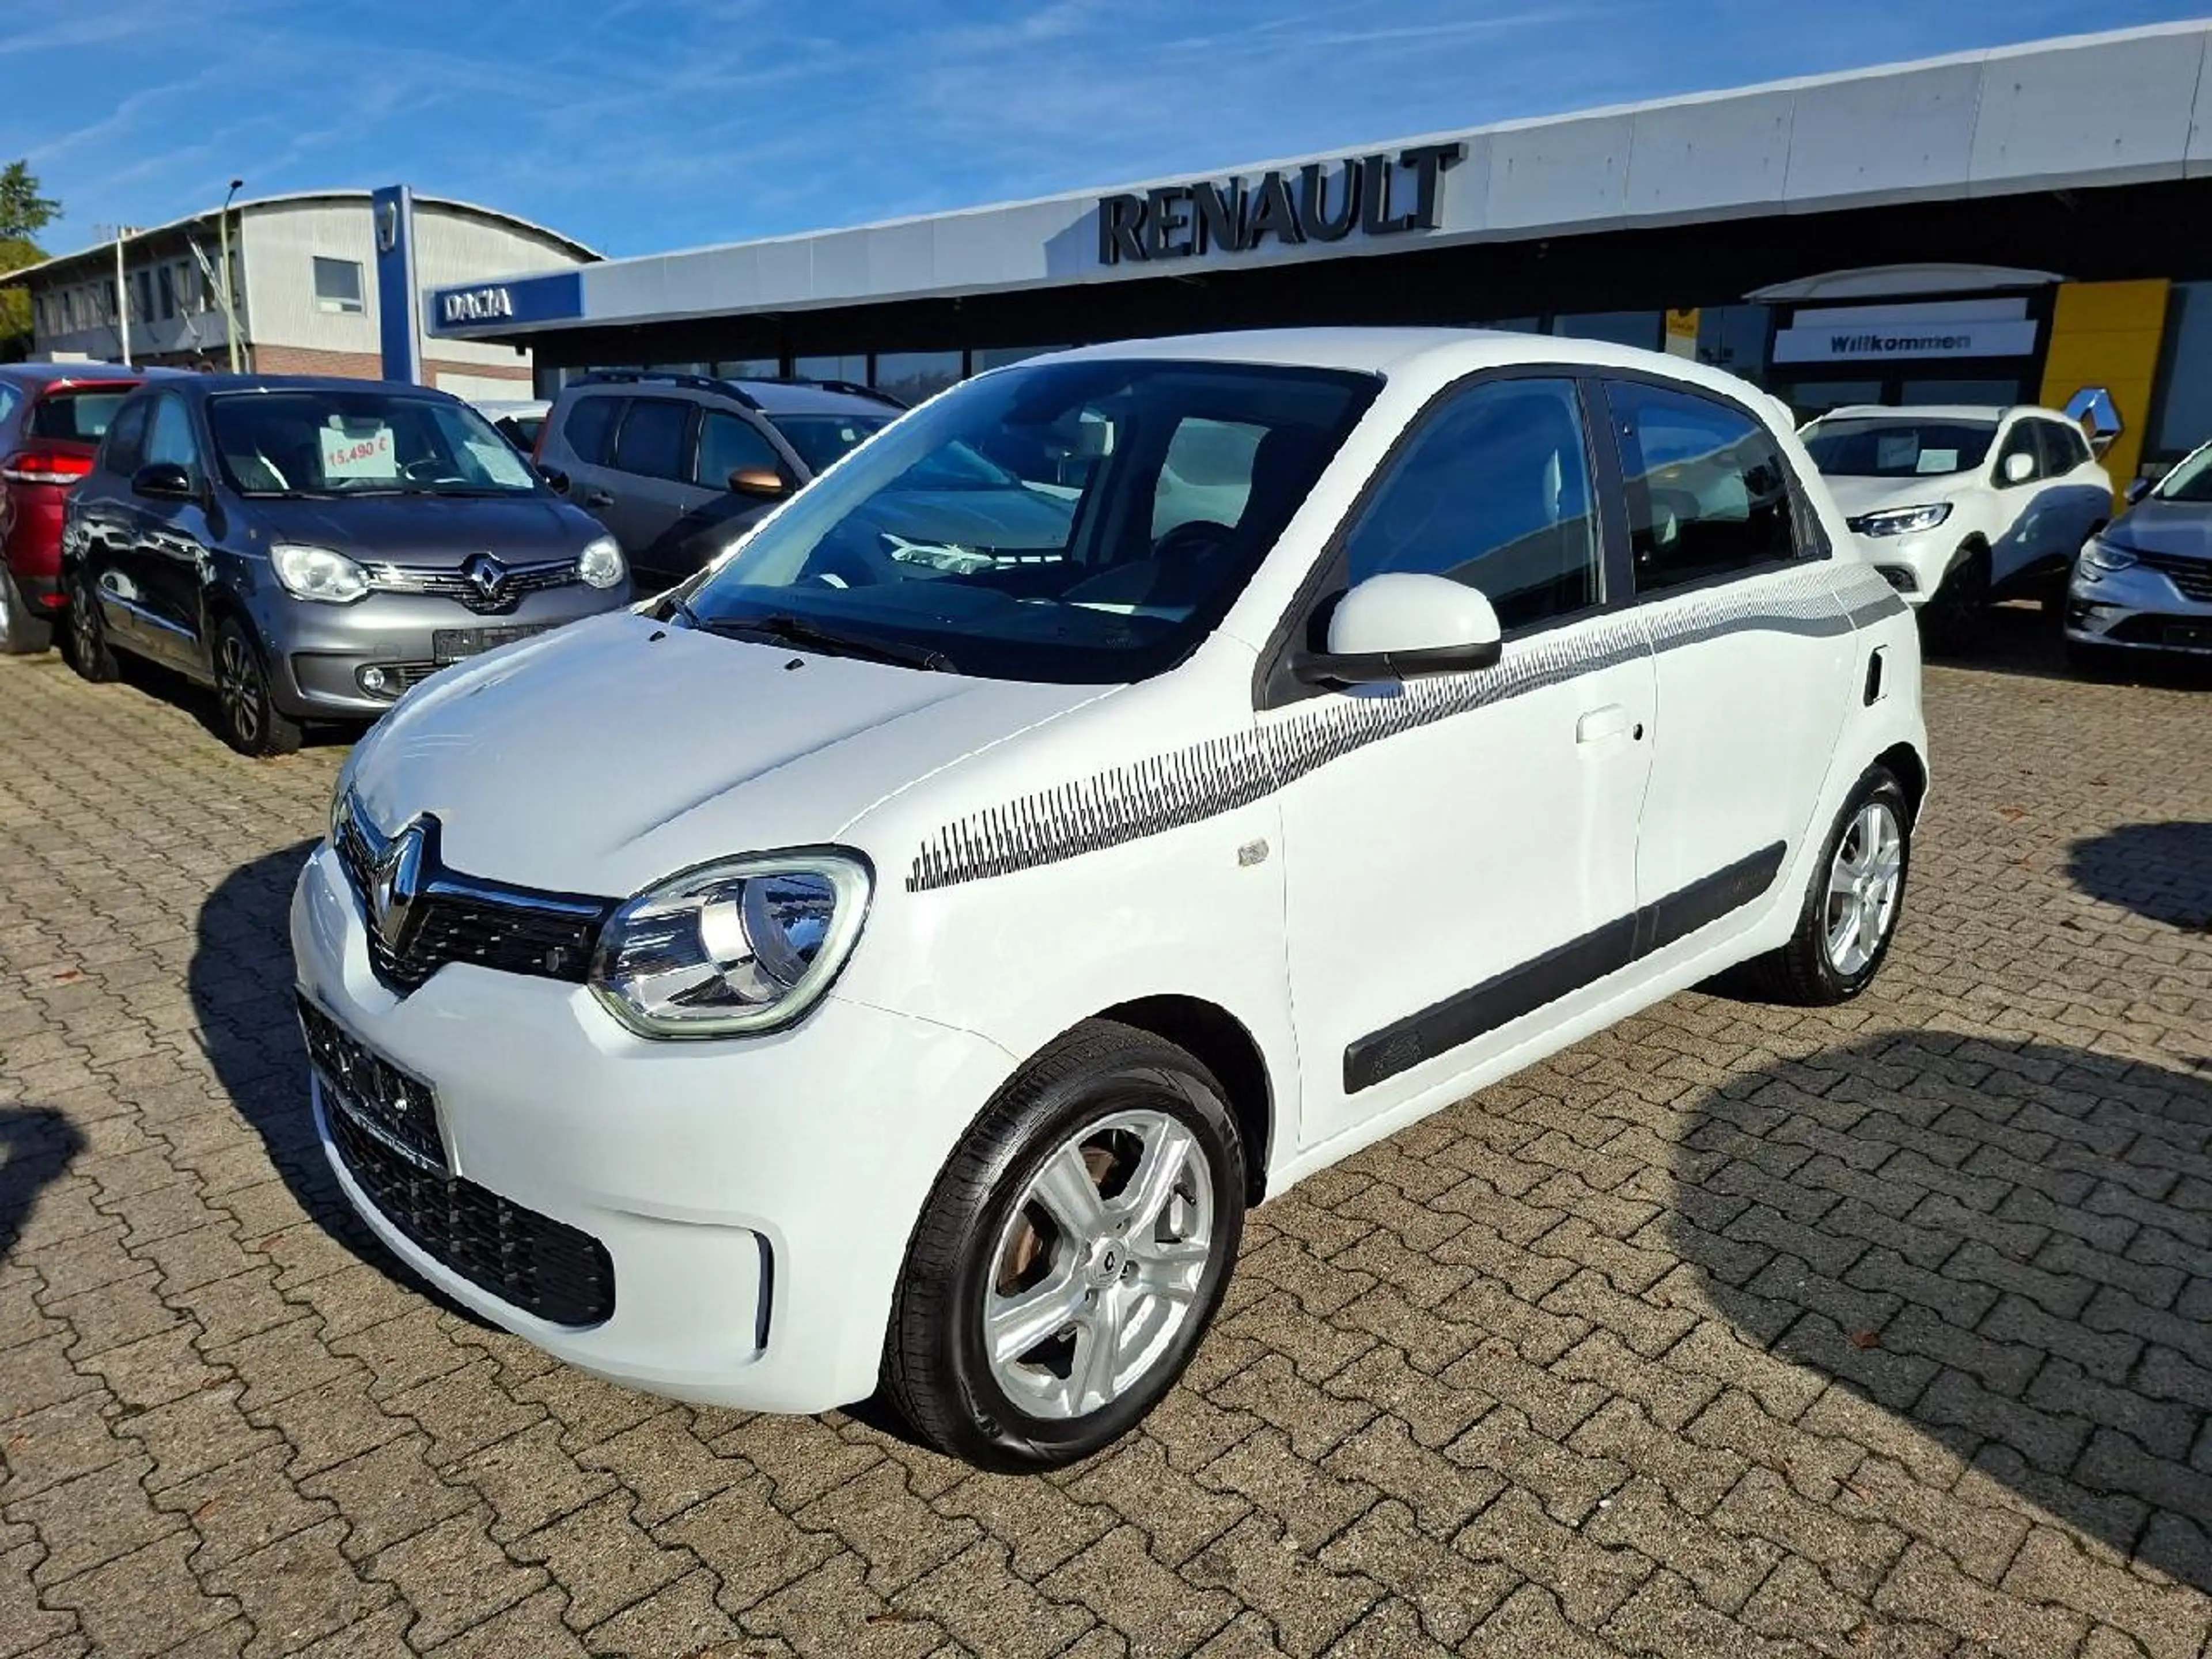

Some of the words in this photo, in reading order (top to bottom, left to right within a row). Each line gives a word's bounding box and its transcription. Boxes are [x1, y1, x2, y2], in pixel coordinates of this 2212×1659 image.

[1098, 142, 1468, 264] RENAULT
[445, 288, 512, 321] DACIA
[1831, 334, 1972, 353] Willkommen
